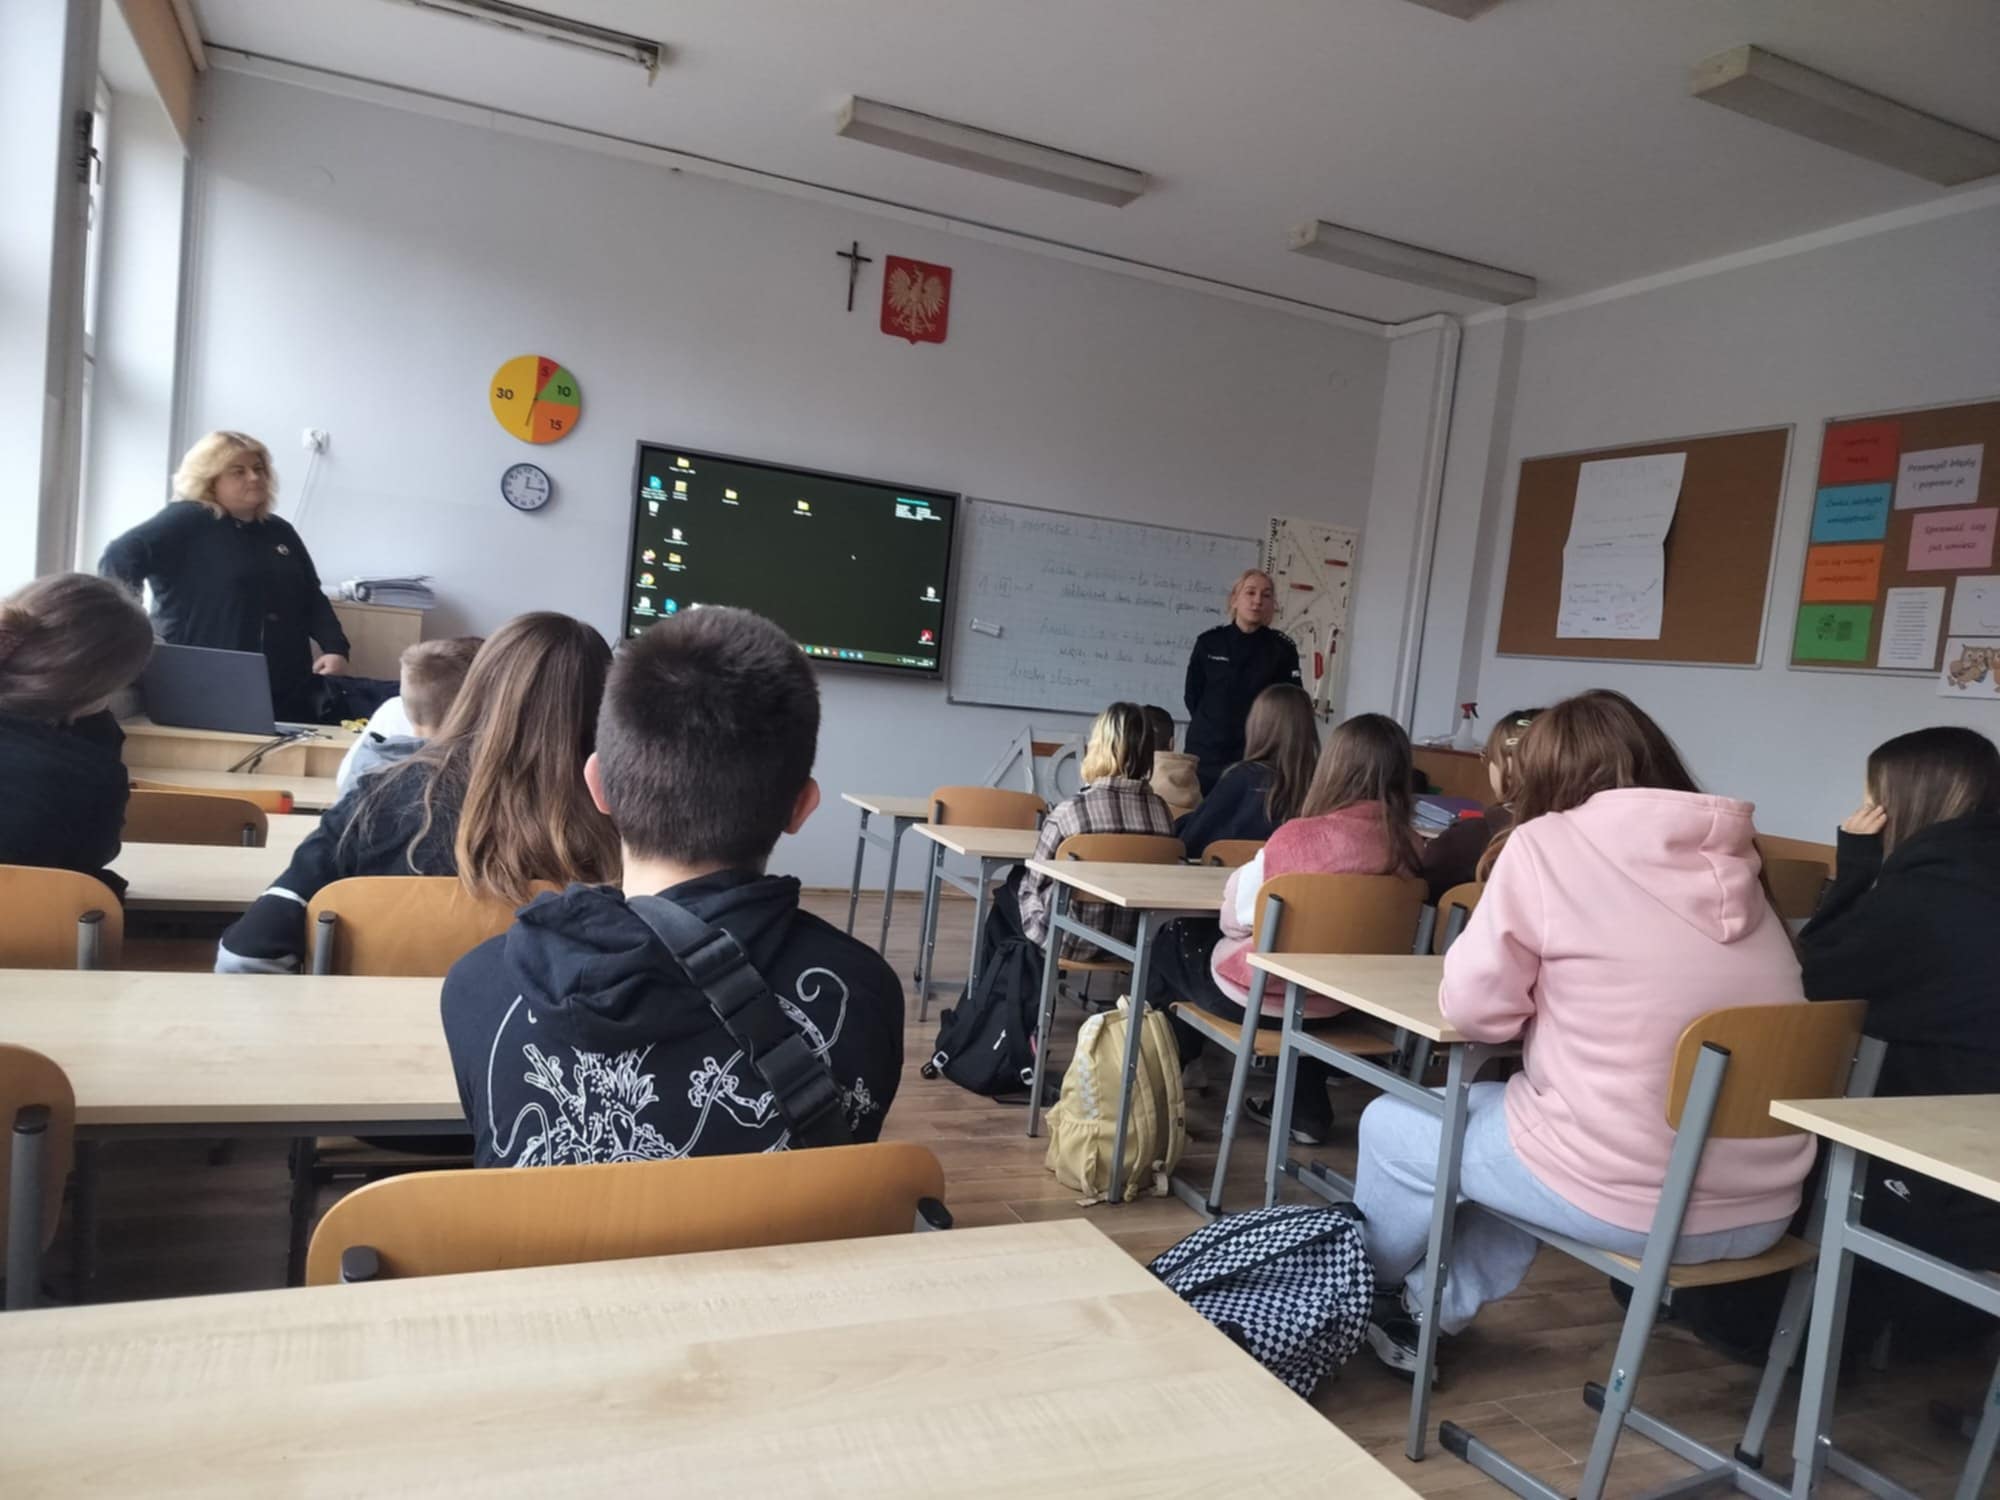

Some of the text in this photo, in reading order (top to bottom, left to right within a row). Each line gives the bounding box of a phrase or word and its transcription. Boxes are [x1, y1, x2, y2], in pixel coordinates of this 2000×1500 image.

[496, 387, 514, 400] 30
[557, 385, 572, 398] 10
[550, 418, 563, 431] 15
